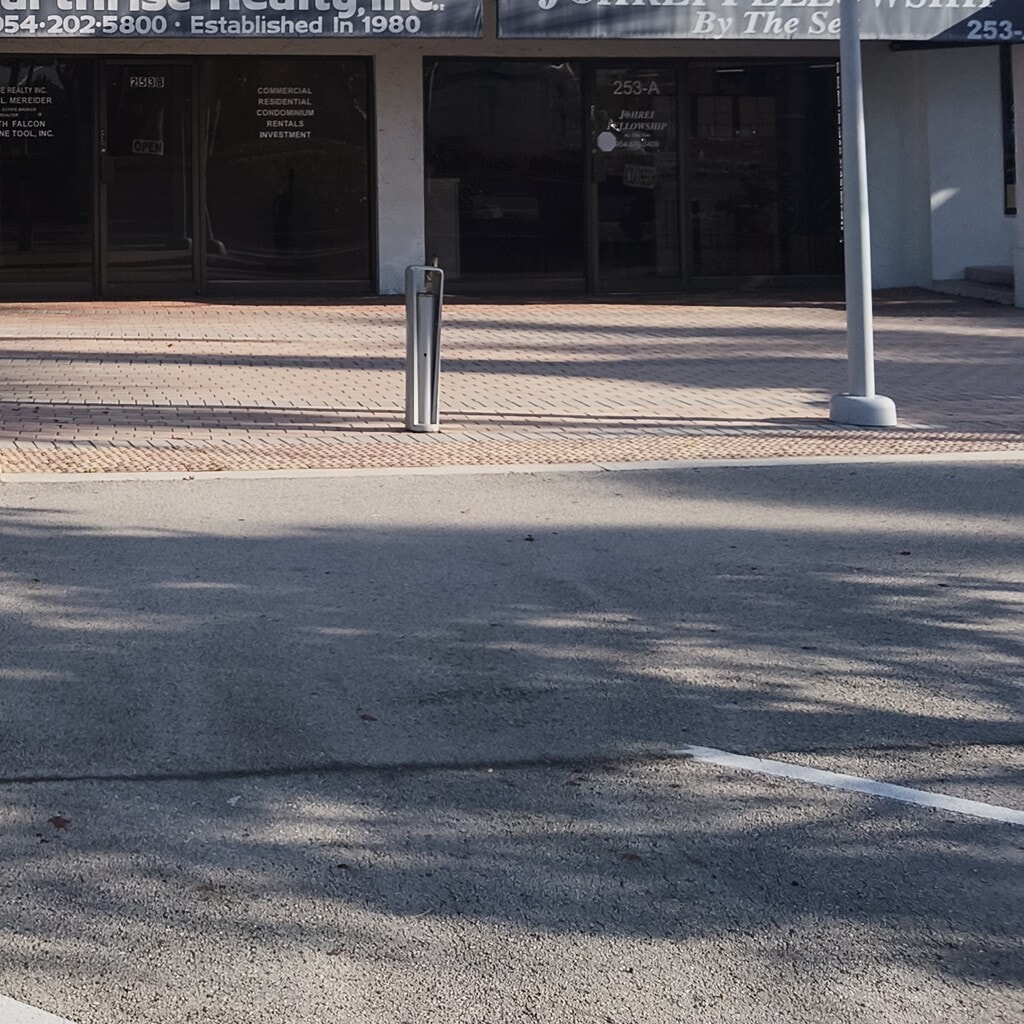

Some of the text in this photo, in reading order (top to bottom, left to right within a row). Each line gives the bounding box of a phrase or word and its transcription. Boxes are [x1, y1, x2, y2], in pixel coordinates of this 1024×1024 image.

[190, 15, 323, 34] Established
[333, 16, 354, 34] In
[362, 15, 421, 34] 1980
[692, 10, 851, 39] By The Se
[966, 19, 1024, 41] 253-
[6, 86, 33, 94] REALTY
[257, 86, 313, 95] COMMERCIAL
[613, 80, 660, 96] 253-A
[9, 96, 53, 105] MEREIDER
[257, 97, 312, 106] RESIDENTIAL
[256, 108, 315, 117] CONDOMINIUM
[12, 120, 46, 128] FALCON
[266, 119, 305, 128] RENTALS
[11, 129, 37, 138] TOOL,
[38, 130, 55, 138] INC.
[259, 130, 312, 139] INVESTMENT
